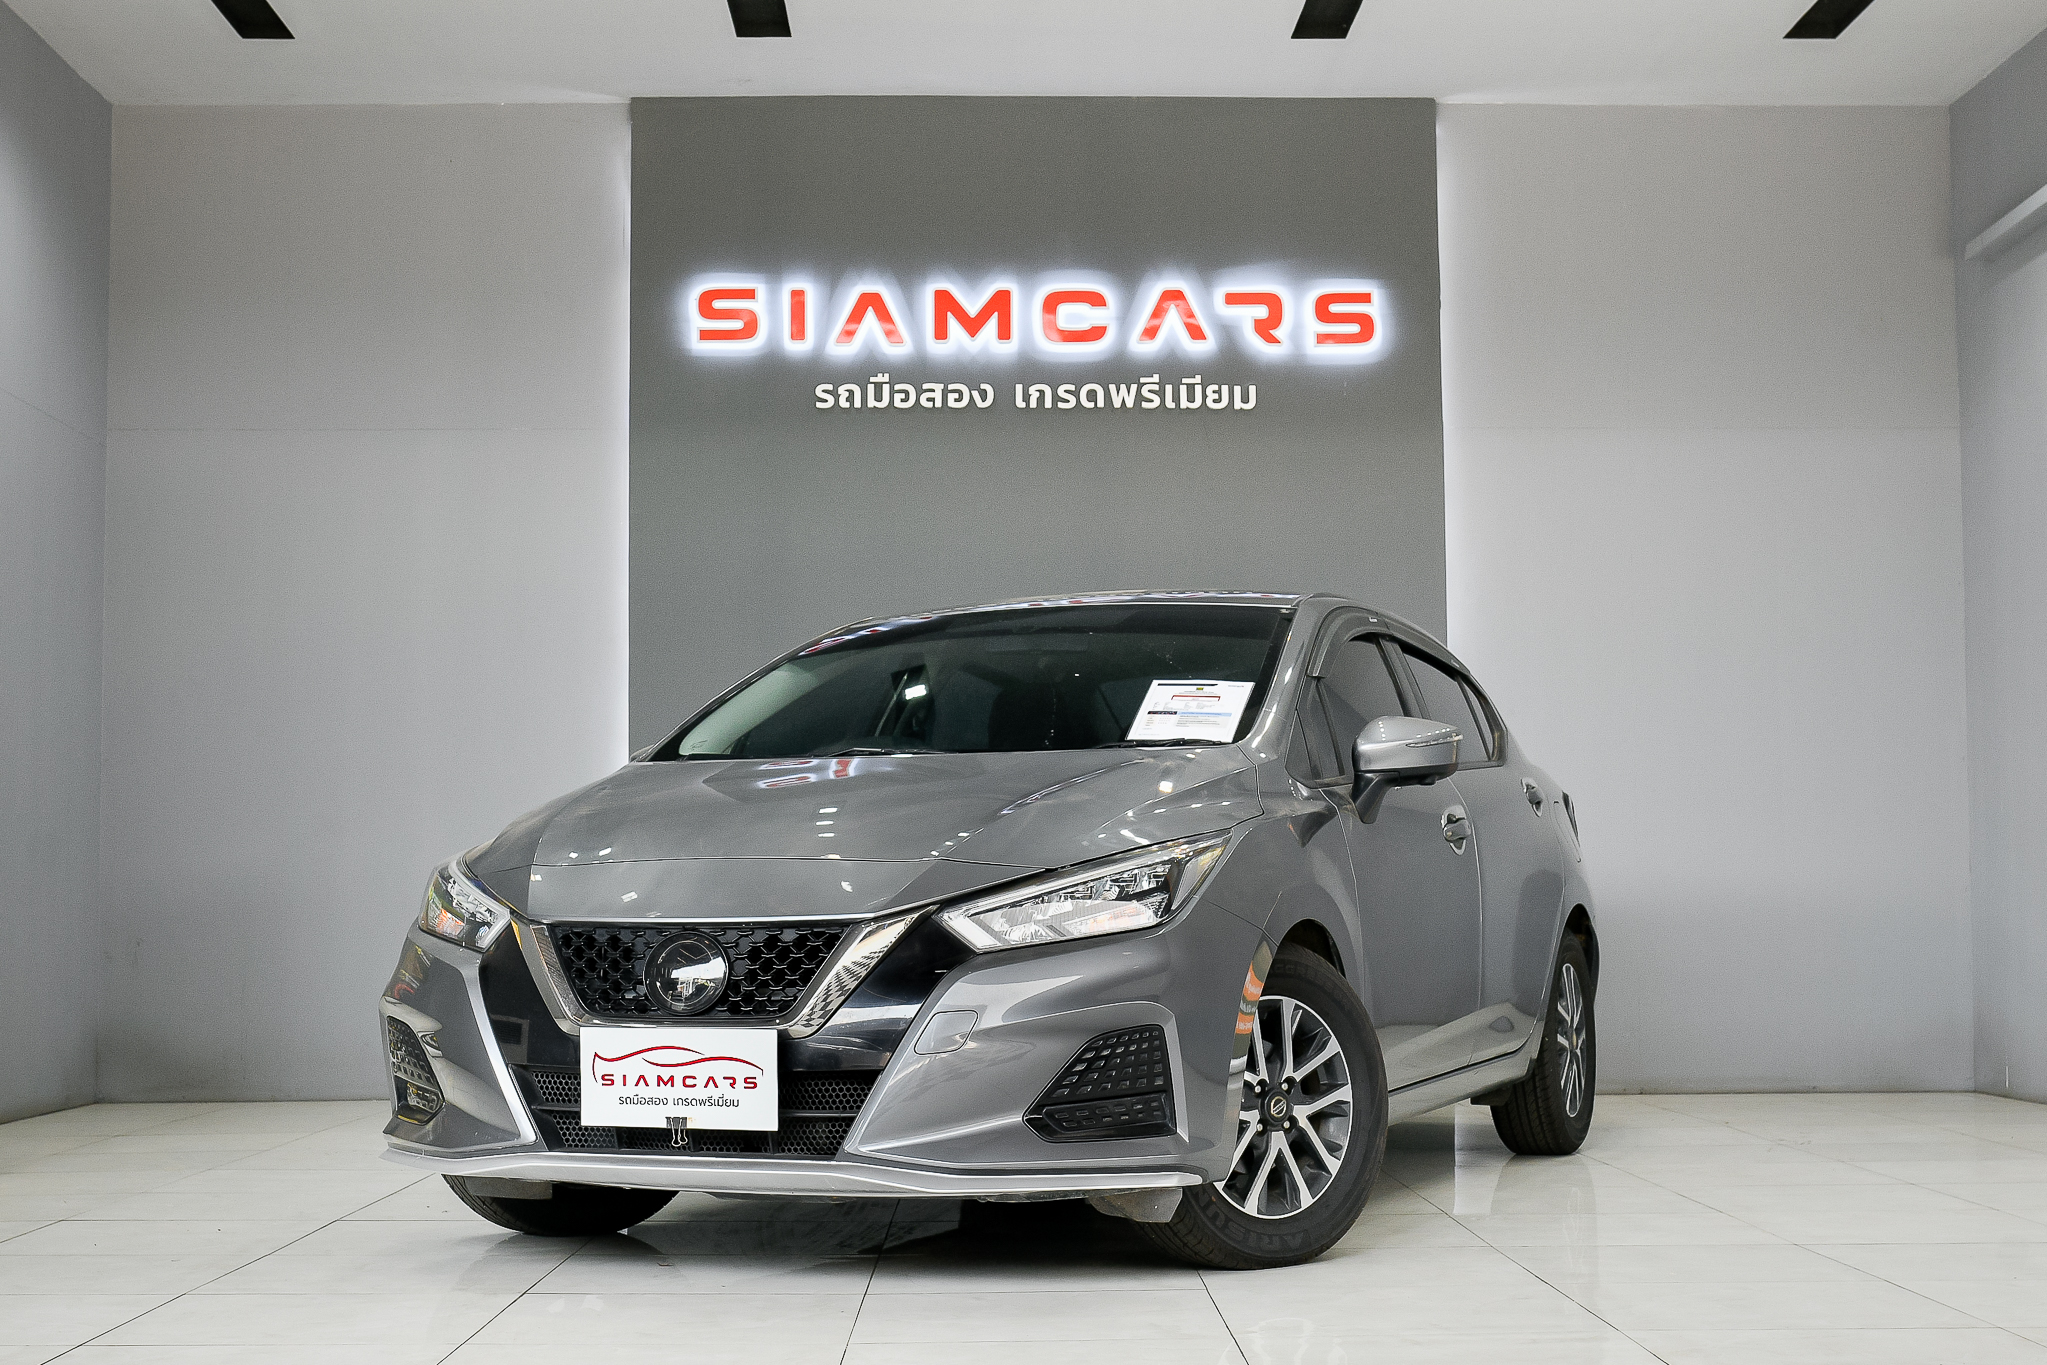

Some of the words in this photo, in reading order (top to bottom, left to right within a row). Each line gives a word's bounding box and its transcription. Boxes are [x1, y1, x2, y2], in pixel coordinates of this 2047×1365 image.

[696, 288, 1375, 345] SIAMCARS
[814, 372, 995, 409] รถมือสอง
[1014, 373, 1257, 410] เกรดพรีเมียม
[601, 1073, 758, 1090] SIAMCARS
[618, 1094, 669, 1106] รถมือสอง
